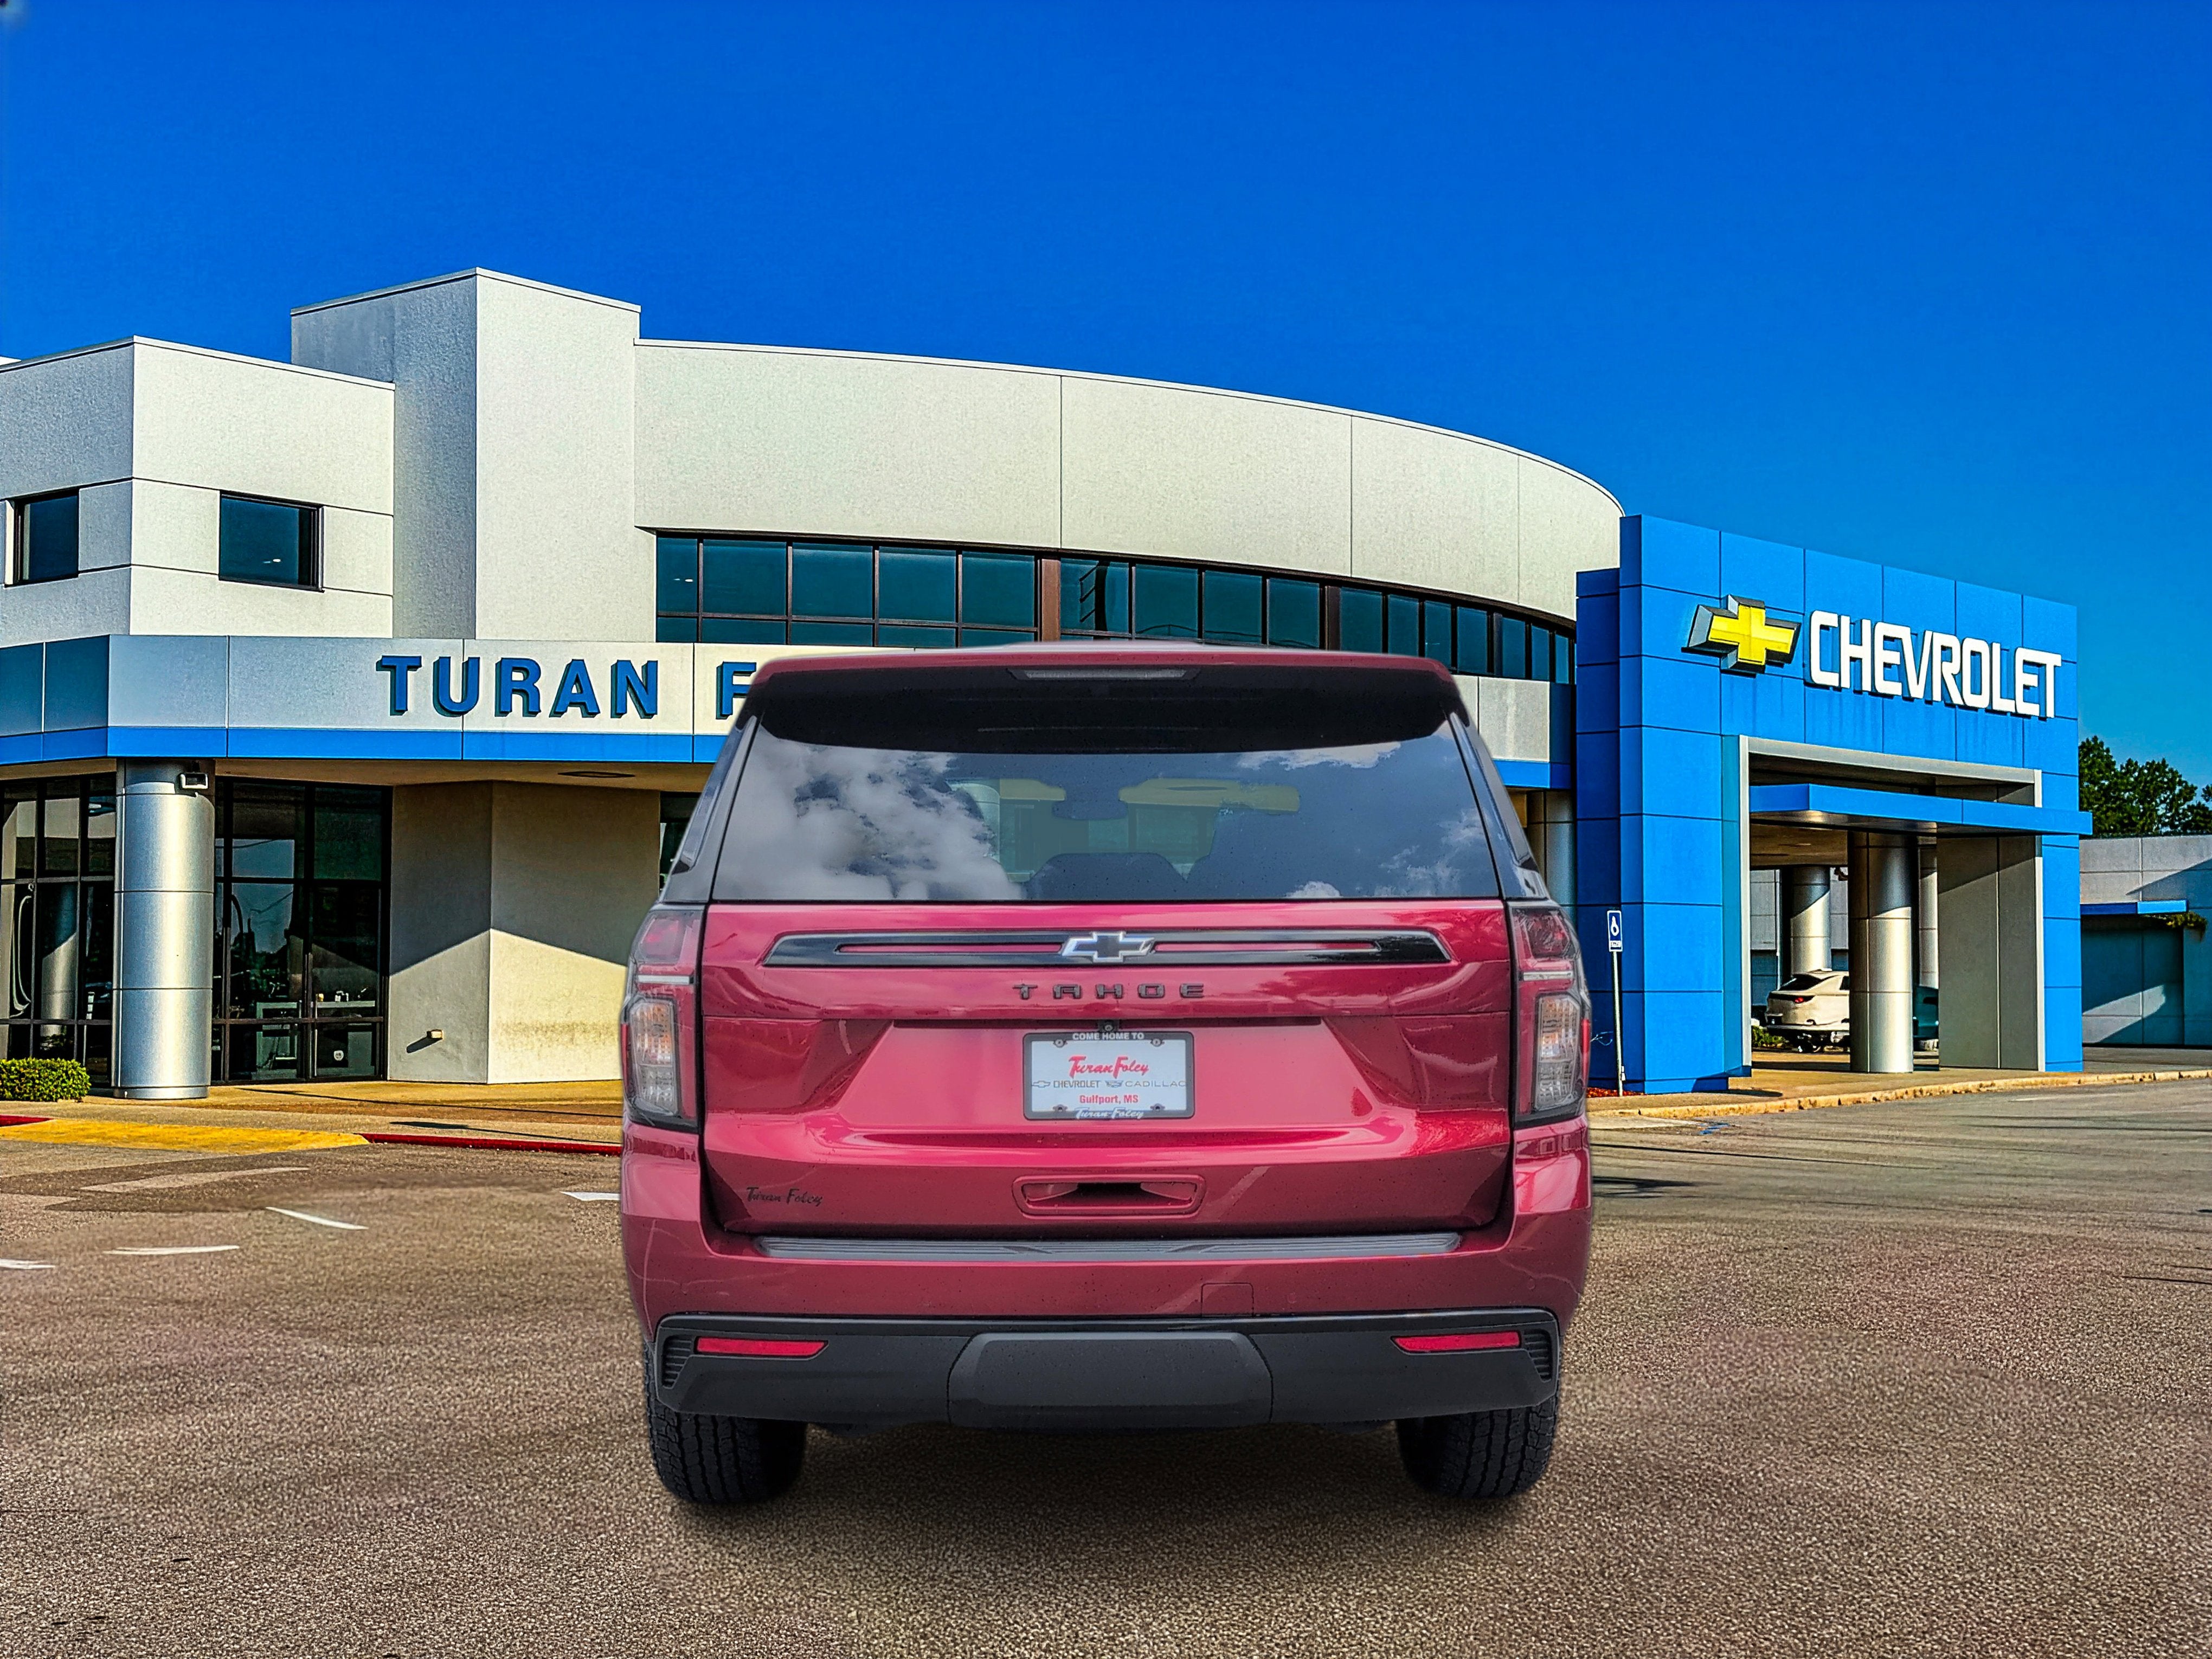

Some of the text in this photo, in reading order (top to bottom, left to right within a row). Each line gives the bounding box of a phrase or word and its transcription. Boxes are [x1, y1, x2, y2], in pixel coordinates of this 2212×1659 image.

[1809, 610, 2062, 719] CHEVROLET
[376, 655, 659, 720] TURAN
[1012, 983, 1205, 999] TAHOE
[1072, 1032, 1099, 1040] COME
[1131, 1032, 1144, 1040] TO
[1069, 1056, 1149, 1079] Turan Foley
[1053, 1080, 1100, 1088] CHEVROLET
[1079, 1094, 1139, 1104] Gulfport, MS
[1075, 1107, 1144, 1120] Turan Foley
[747, 1187, 823, 1207] Turan Foley
